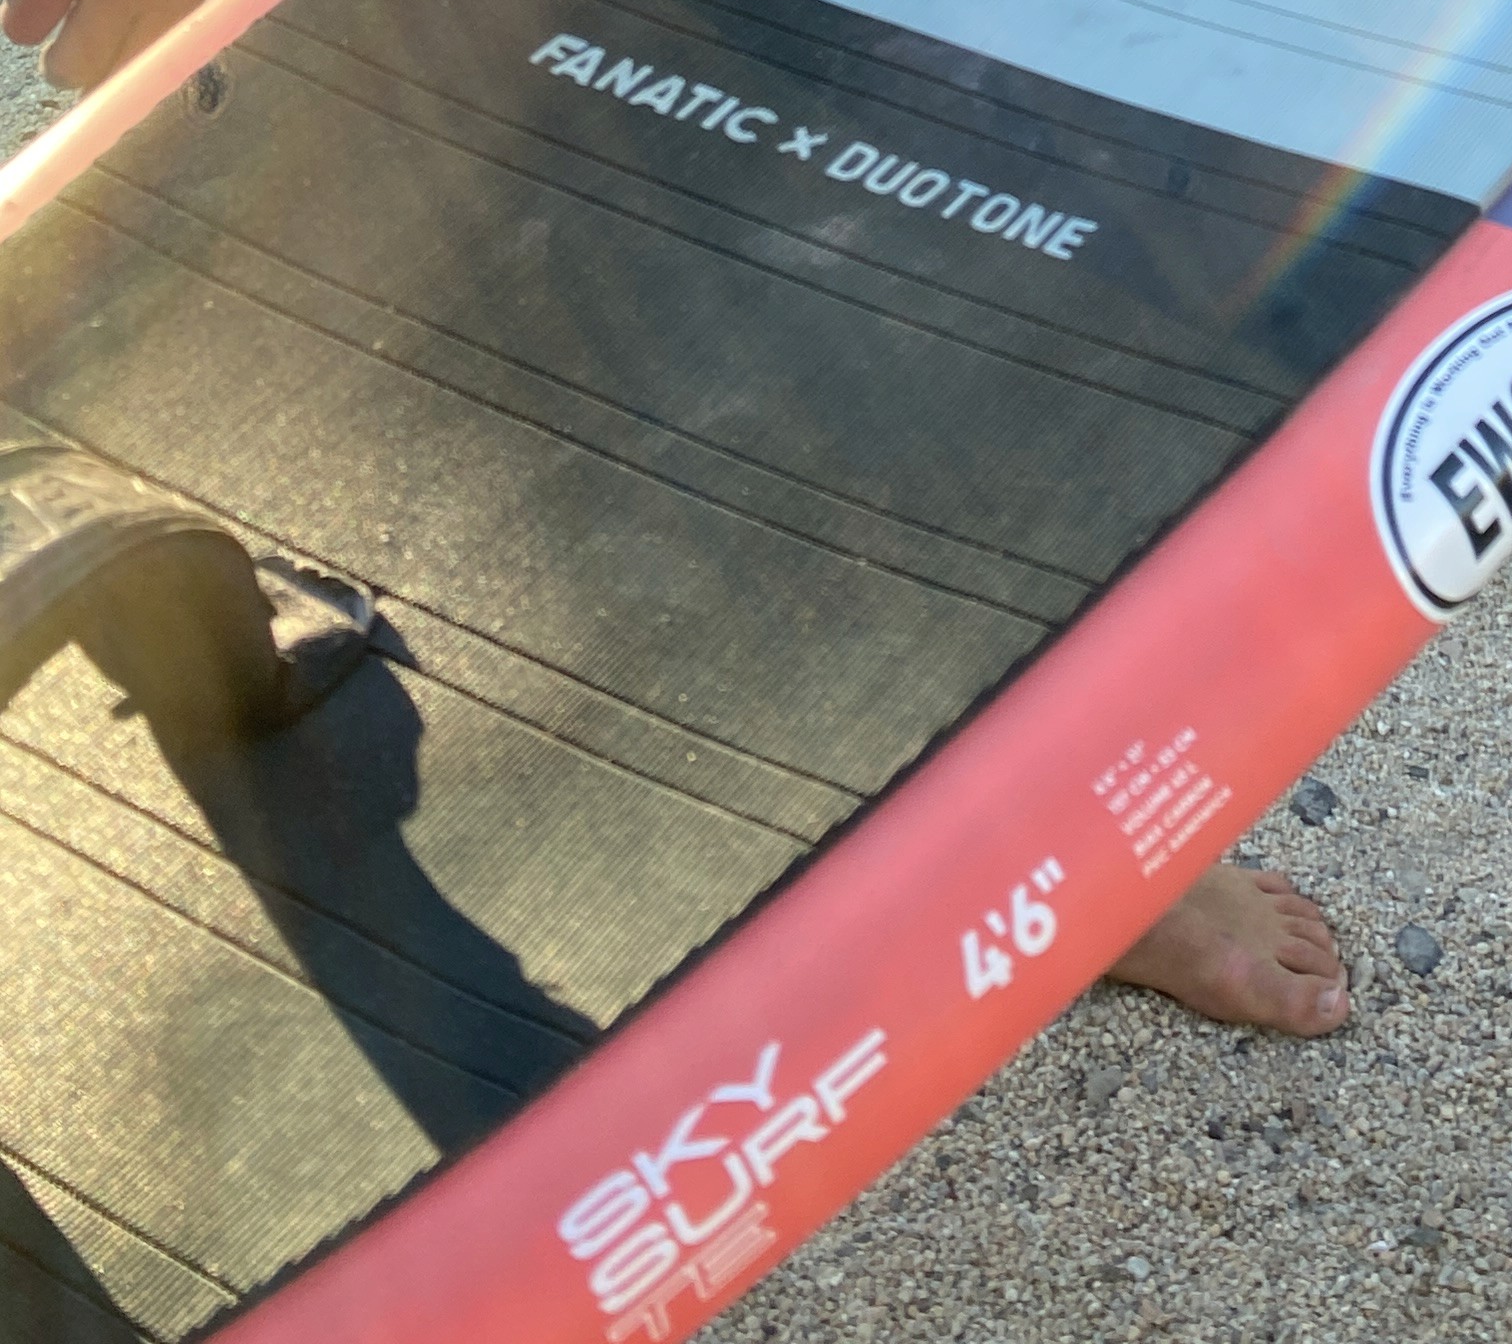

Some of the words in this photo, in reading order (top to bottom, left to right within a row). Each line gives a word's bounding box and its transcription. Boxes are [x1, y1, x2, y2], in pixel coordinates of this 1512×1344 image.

[528, 31, 780, 146] FANATIC
[823, 140, 1100, 262] DUOTONE
[555, 1039, 782, 1262] SKY
[587, 1024, 889, 1315] SURF
